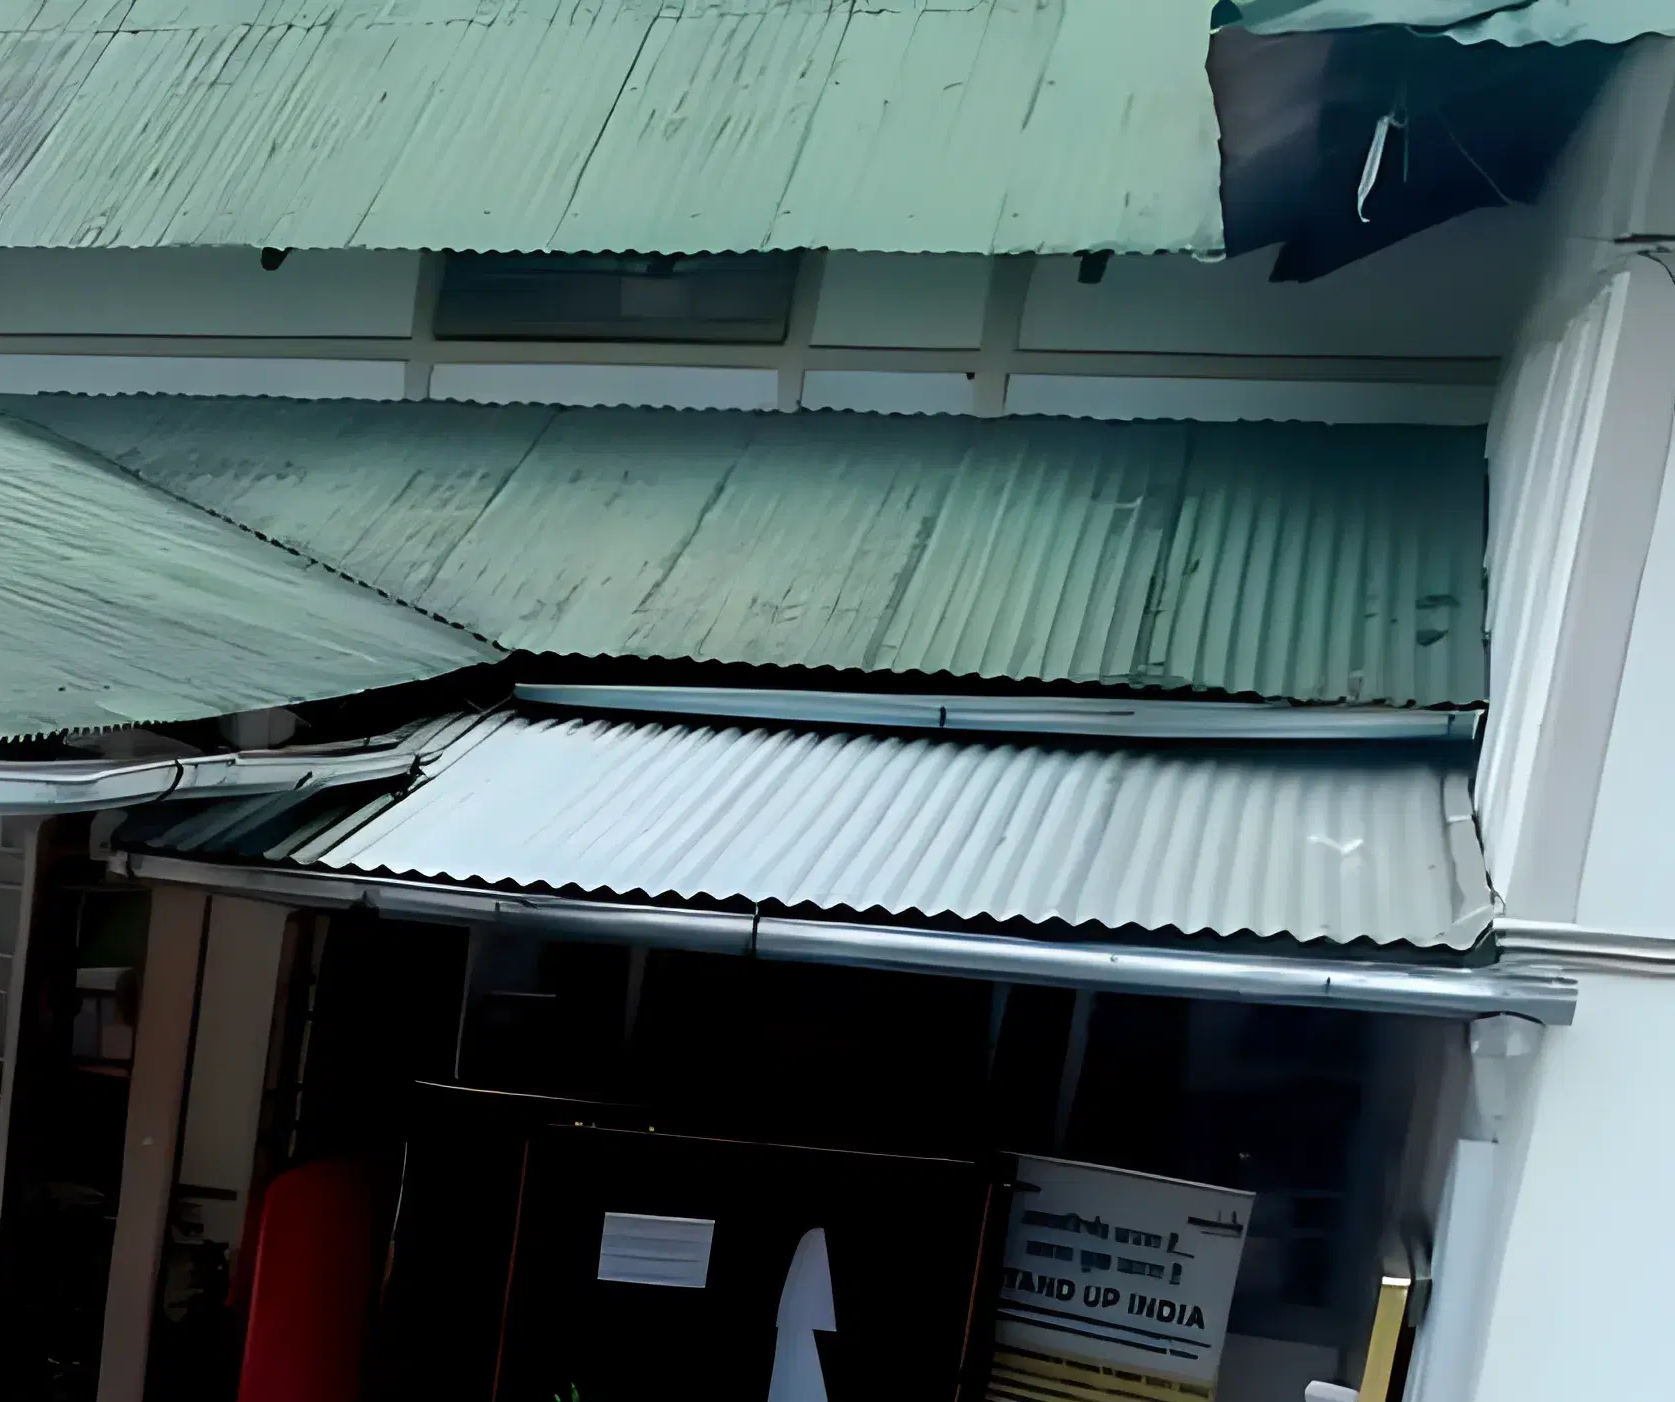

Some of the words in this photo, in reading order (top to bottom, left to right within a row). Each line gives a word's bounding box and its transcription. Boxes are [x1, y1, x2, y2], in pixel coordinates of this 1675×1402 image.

[1001, 1267, 1076, 1302] TAND
[1083, 1284, 1121, 1308] UP
[1127, 1292, 1206, 1330] INDIA
